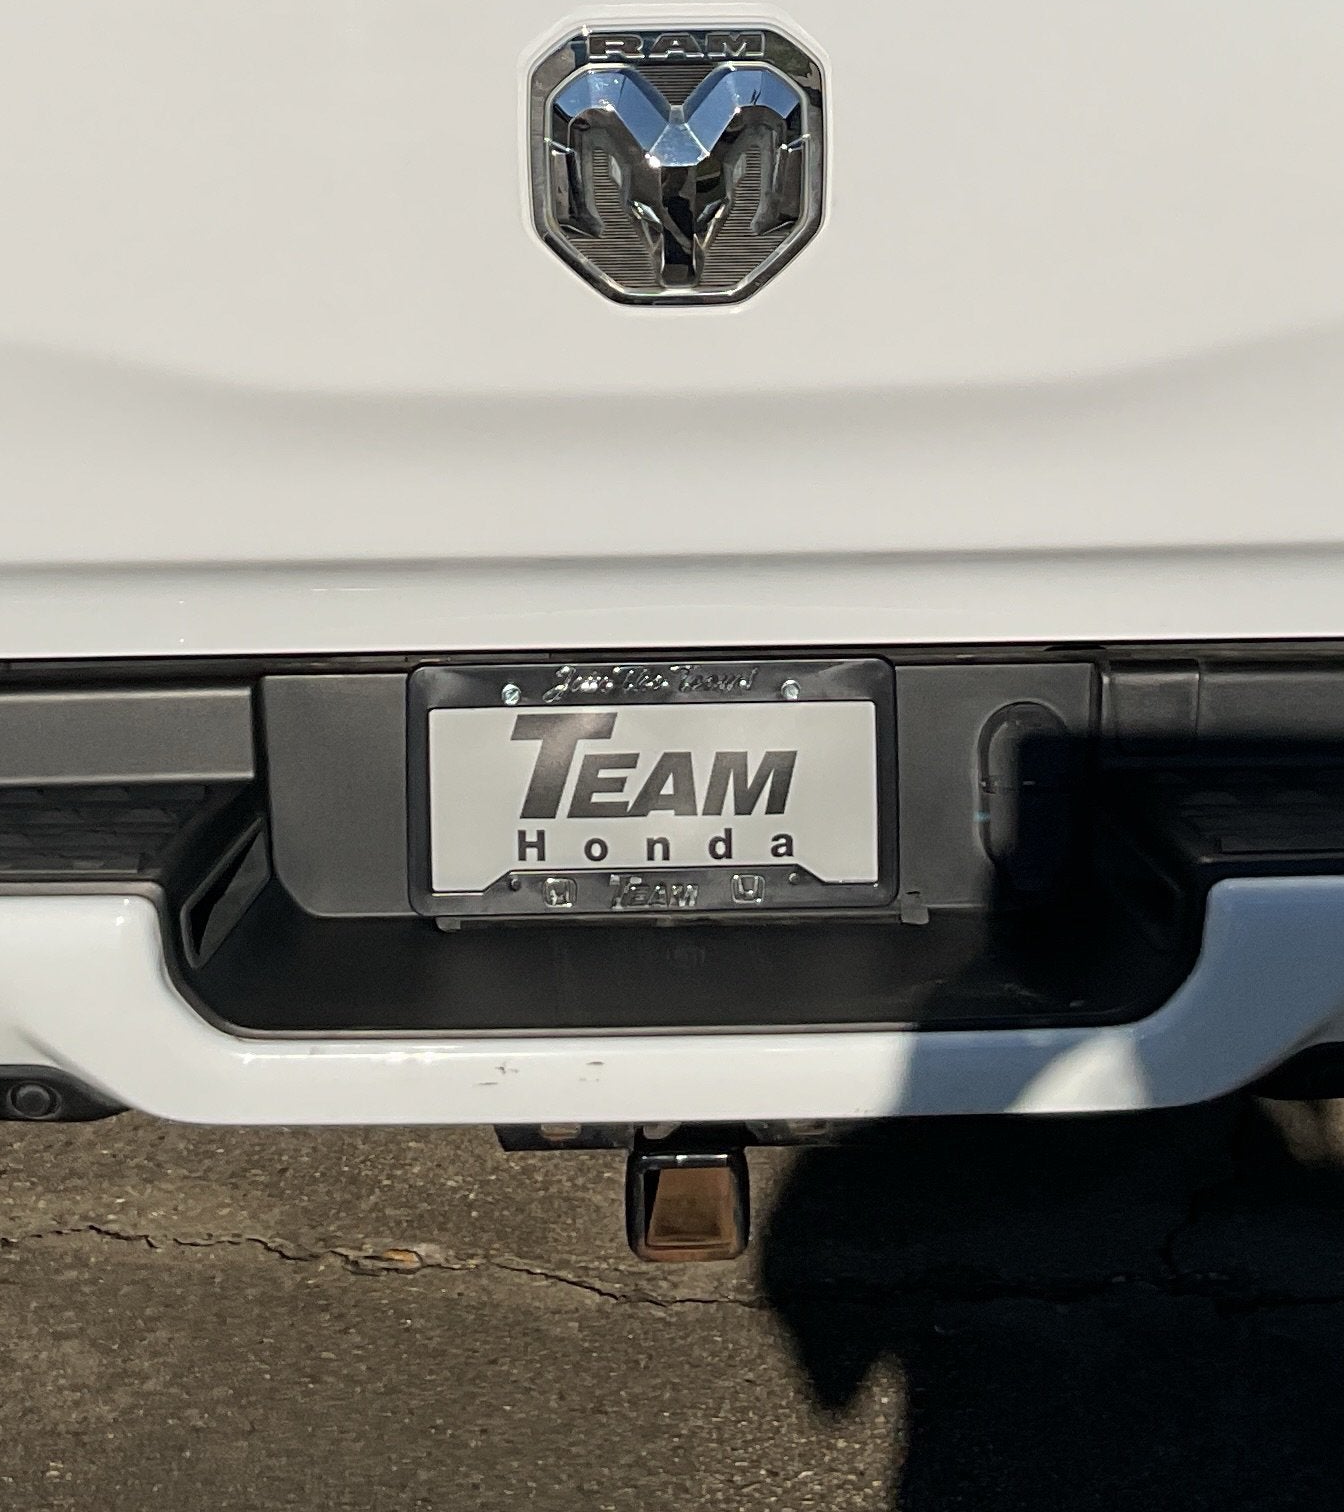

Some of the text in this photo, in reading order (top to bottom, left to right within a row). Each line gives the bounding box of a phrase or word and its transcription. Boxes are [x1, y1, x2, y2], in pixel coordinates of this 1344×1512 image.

[587, 31, 766, 59] RAM
[510, 712, 798, 819] TEAM
[517, 828, 795, 861] Honda
[609, 874, 699, 909] TEAM
